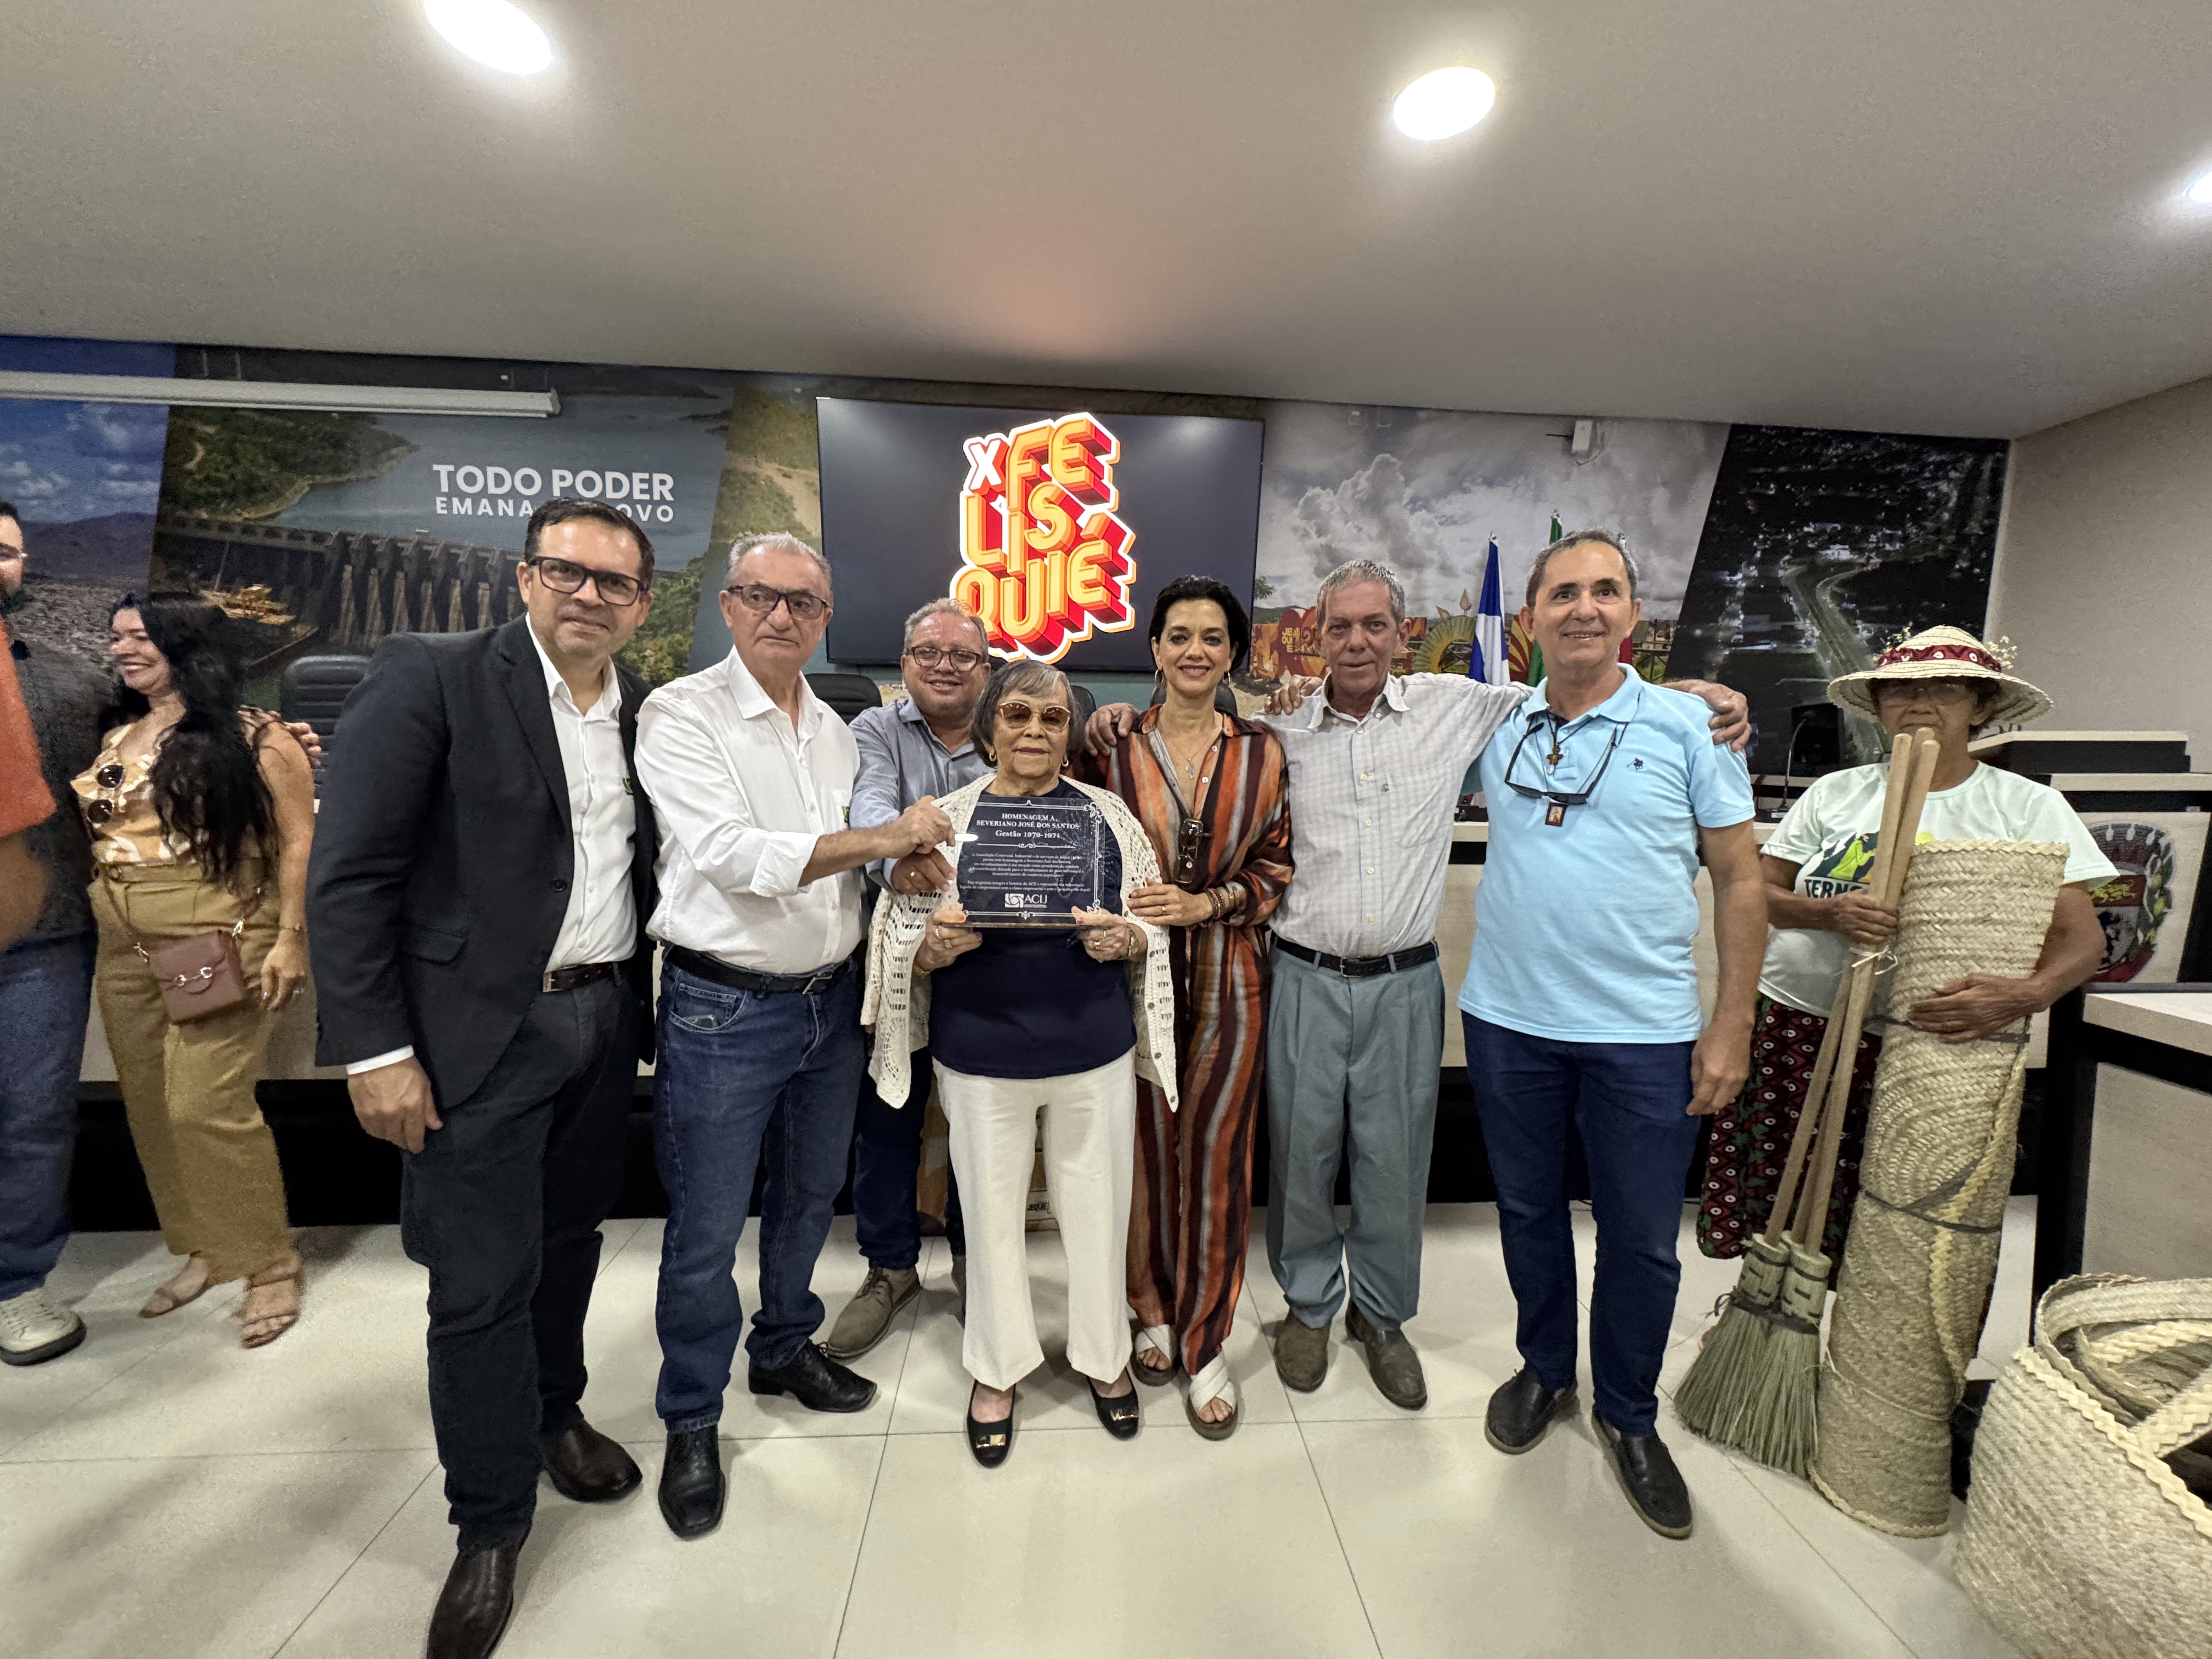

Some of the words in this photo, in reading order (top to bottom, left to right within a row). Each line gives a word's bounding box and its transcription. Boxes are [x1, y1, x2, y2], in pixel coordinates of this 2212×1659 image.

[968, 437, 1007, 493] X
[1006, 417, 1109, 512] FE
[432, 464, 543, 496] TODO
[552, 469, 674, 501] PODER
[436, 496, 534, 517] EMANA
[616, 503, 674, 522] OVO
[964, 481, 1077, 576] LIS
[1002, 812, 1049, 821] HOMENAGEM
[1024, 894, 1048, 904] ACIJ
